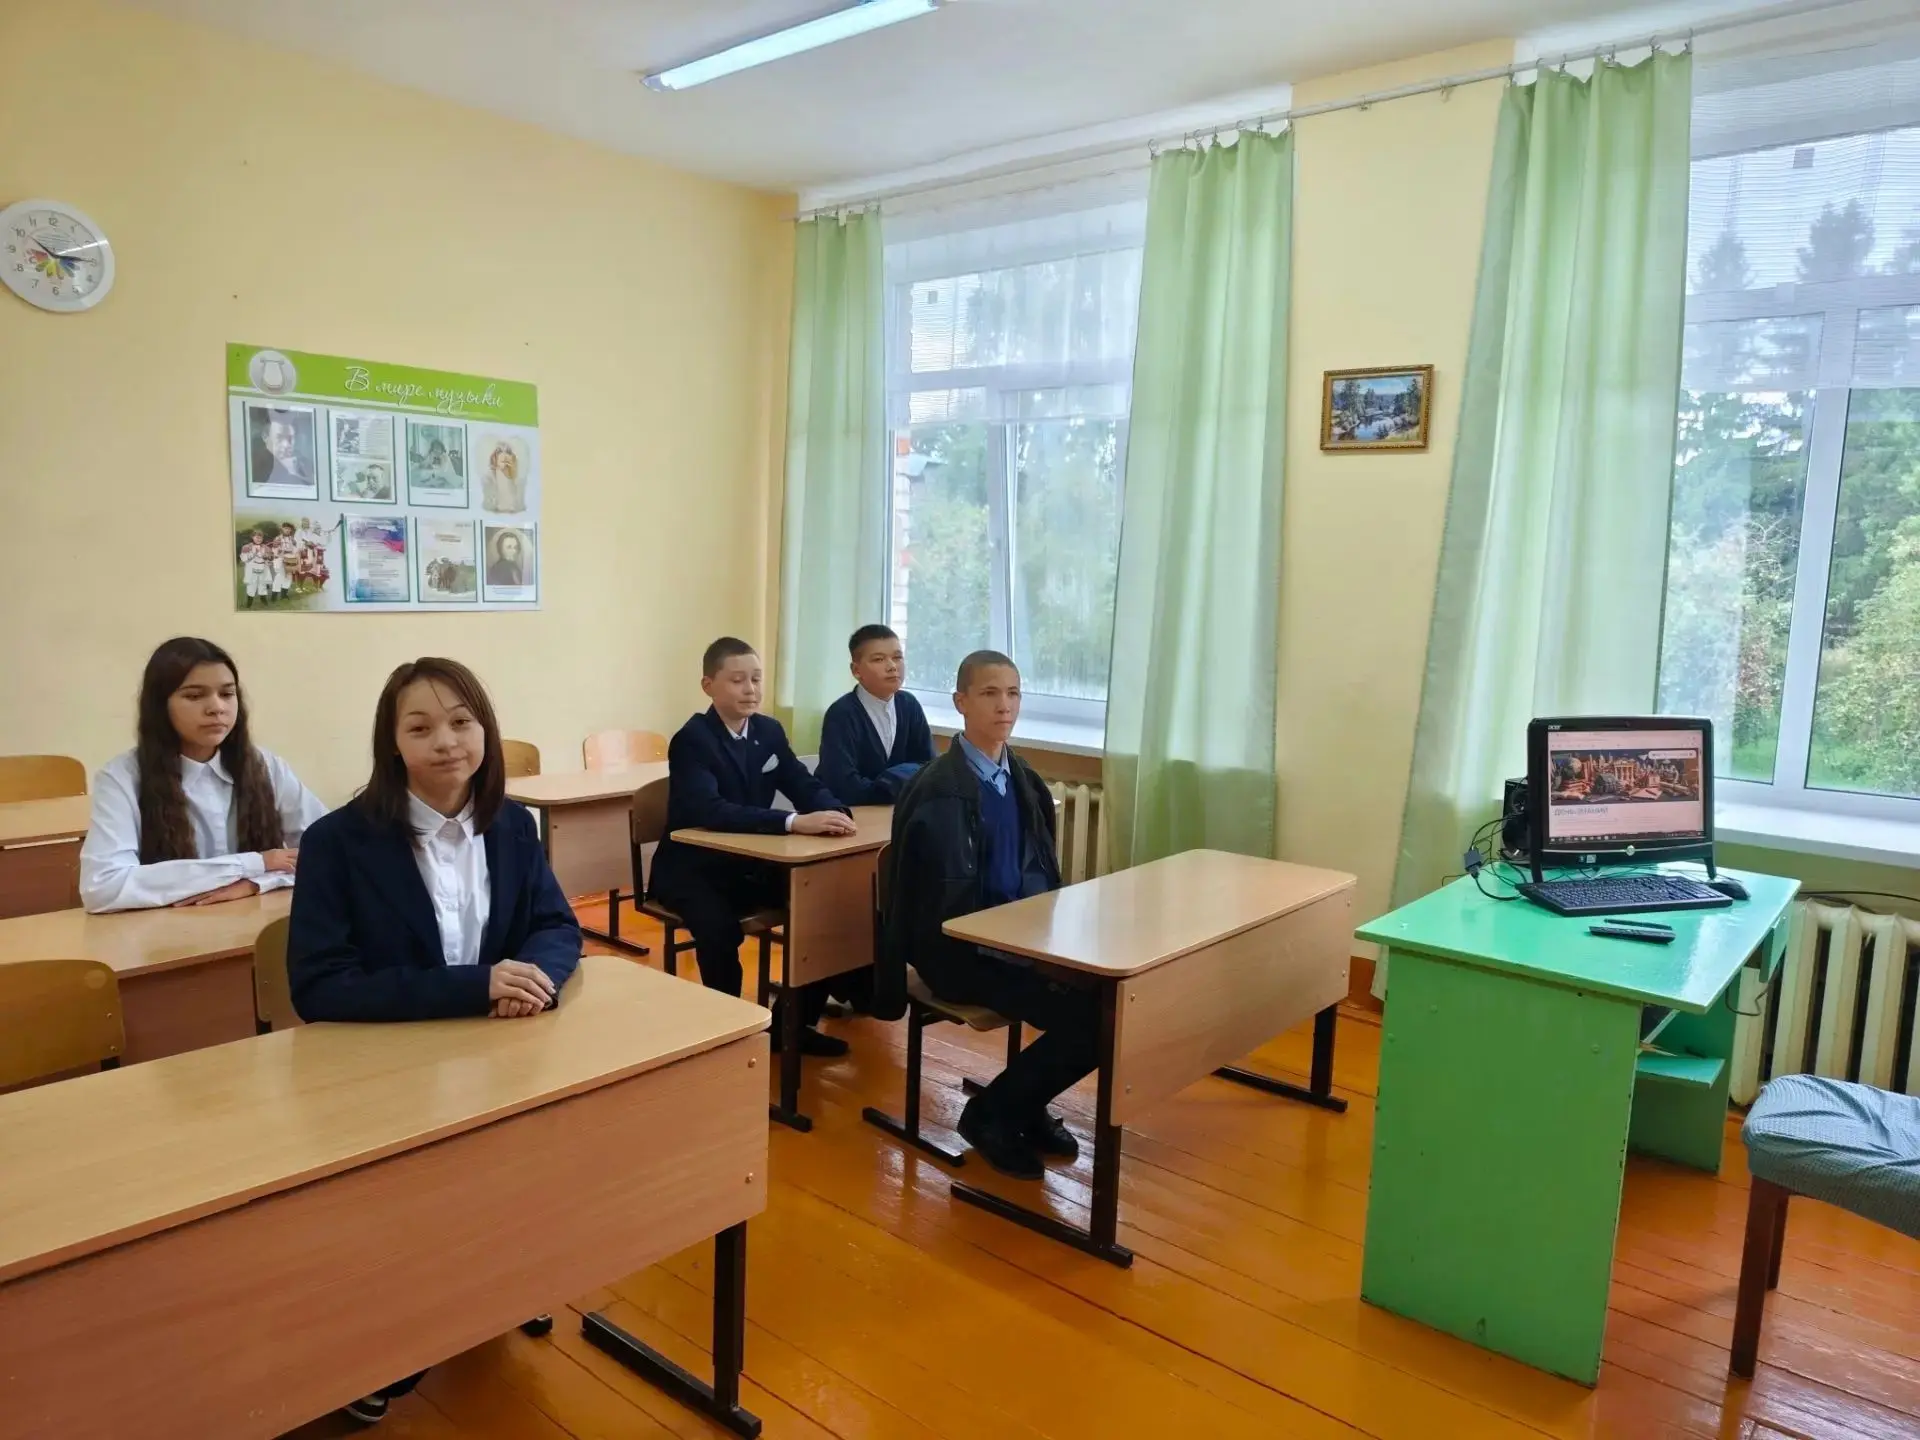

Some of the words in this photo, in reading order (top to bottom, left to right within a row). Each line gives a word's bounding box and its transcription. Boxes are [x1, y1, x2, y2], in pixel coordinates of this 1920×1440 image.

[48, 217, 58, 227] 12
[15, 228, 26, 239] 10
[9, 244, 17, 253] 9
[16, 263, 24, 272] 8
[31, 279, 39, 289] 7
[52, 286, 59, 296] 6
[344, 366, 370, 392] В
[375, 382, 424, 406] мире
[428, 383, 504, 415] музыки
